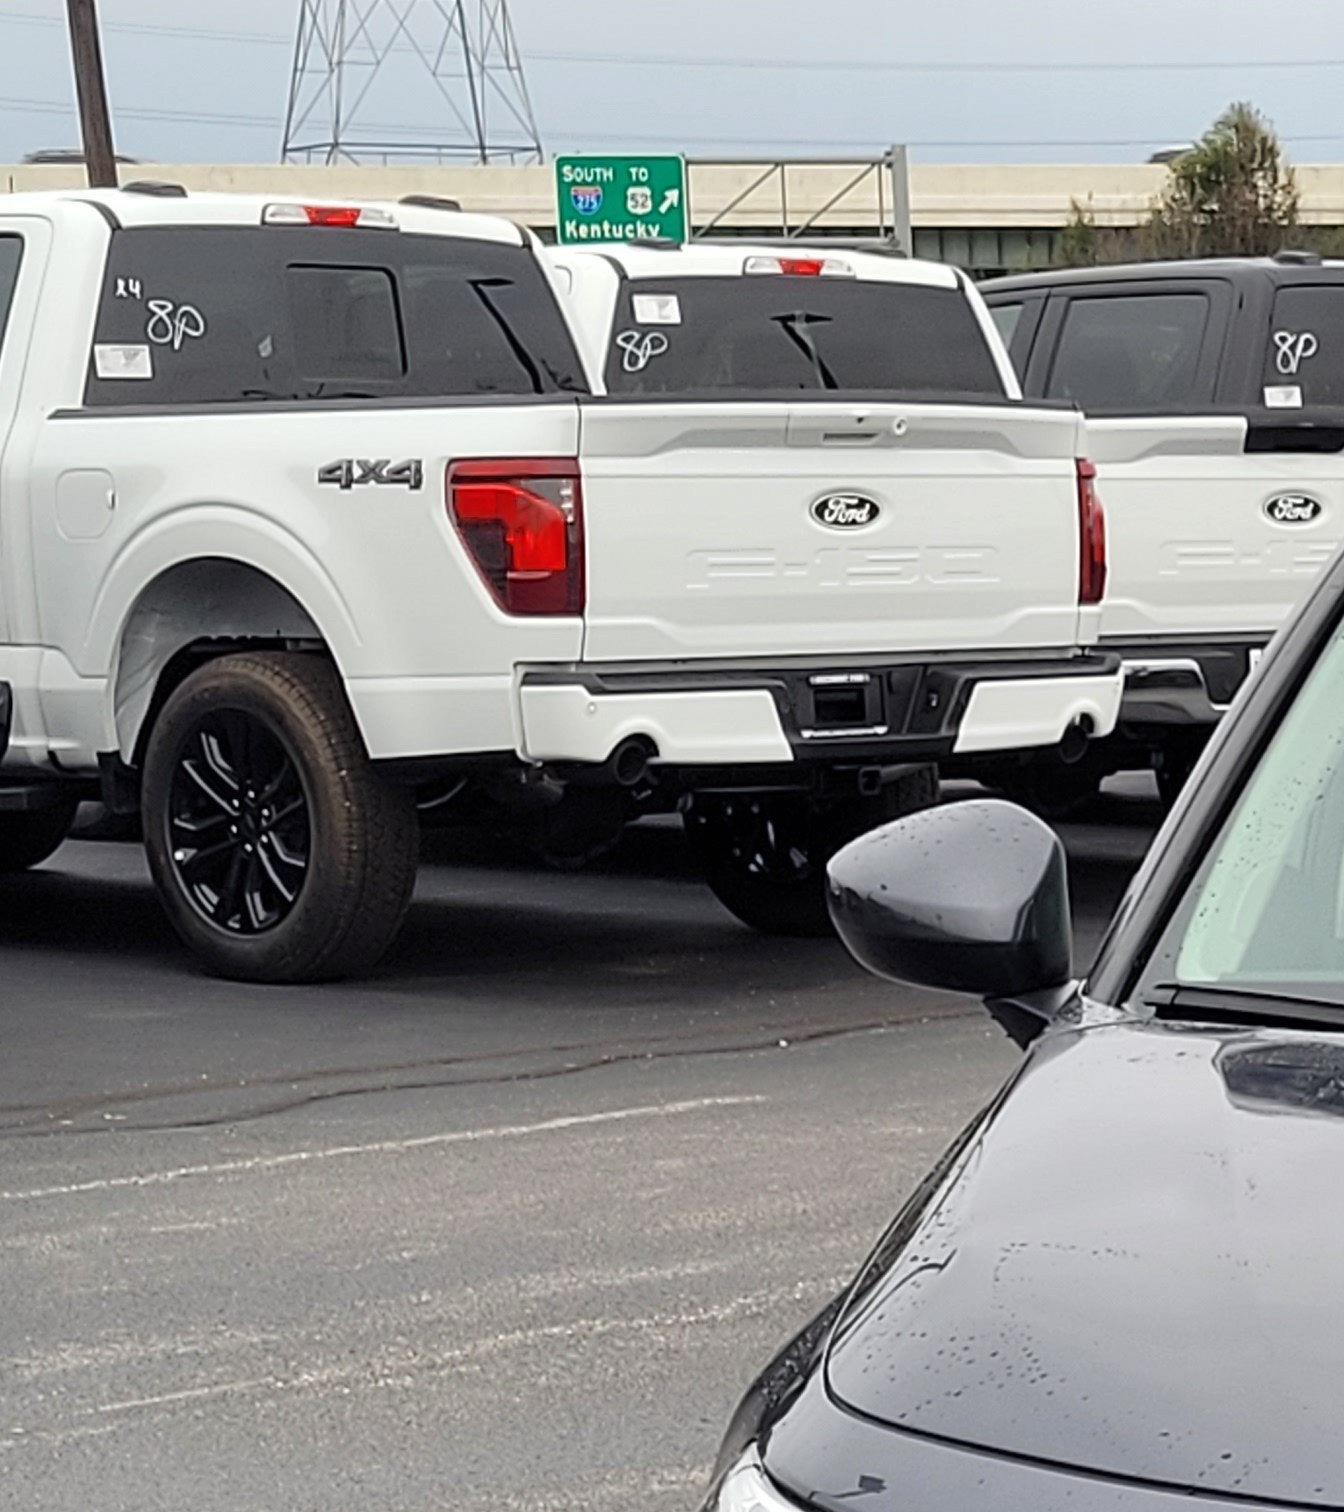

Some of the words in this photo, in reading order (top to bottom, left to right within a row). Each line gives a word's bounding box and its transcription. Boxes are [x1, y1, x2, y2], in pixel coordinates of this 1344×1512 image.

[562, 165, 613, 182] SOUTH
[629, 167, 649, 182] TO
[629, 192, 649, 209] 52
[565, 219, 660, 239] Kentucky
[824, 498, 870, 523] Ford
[1274, 497, 1314, 519] Ford
